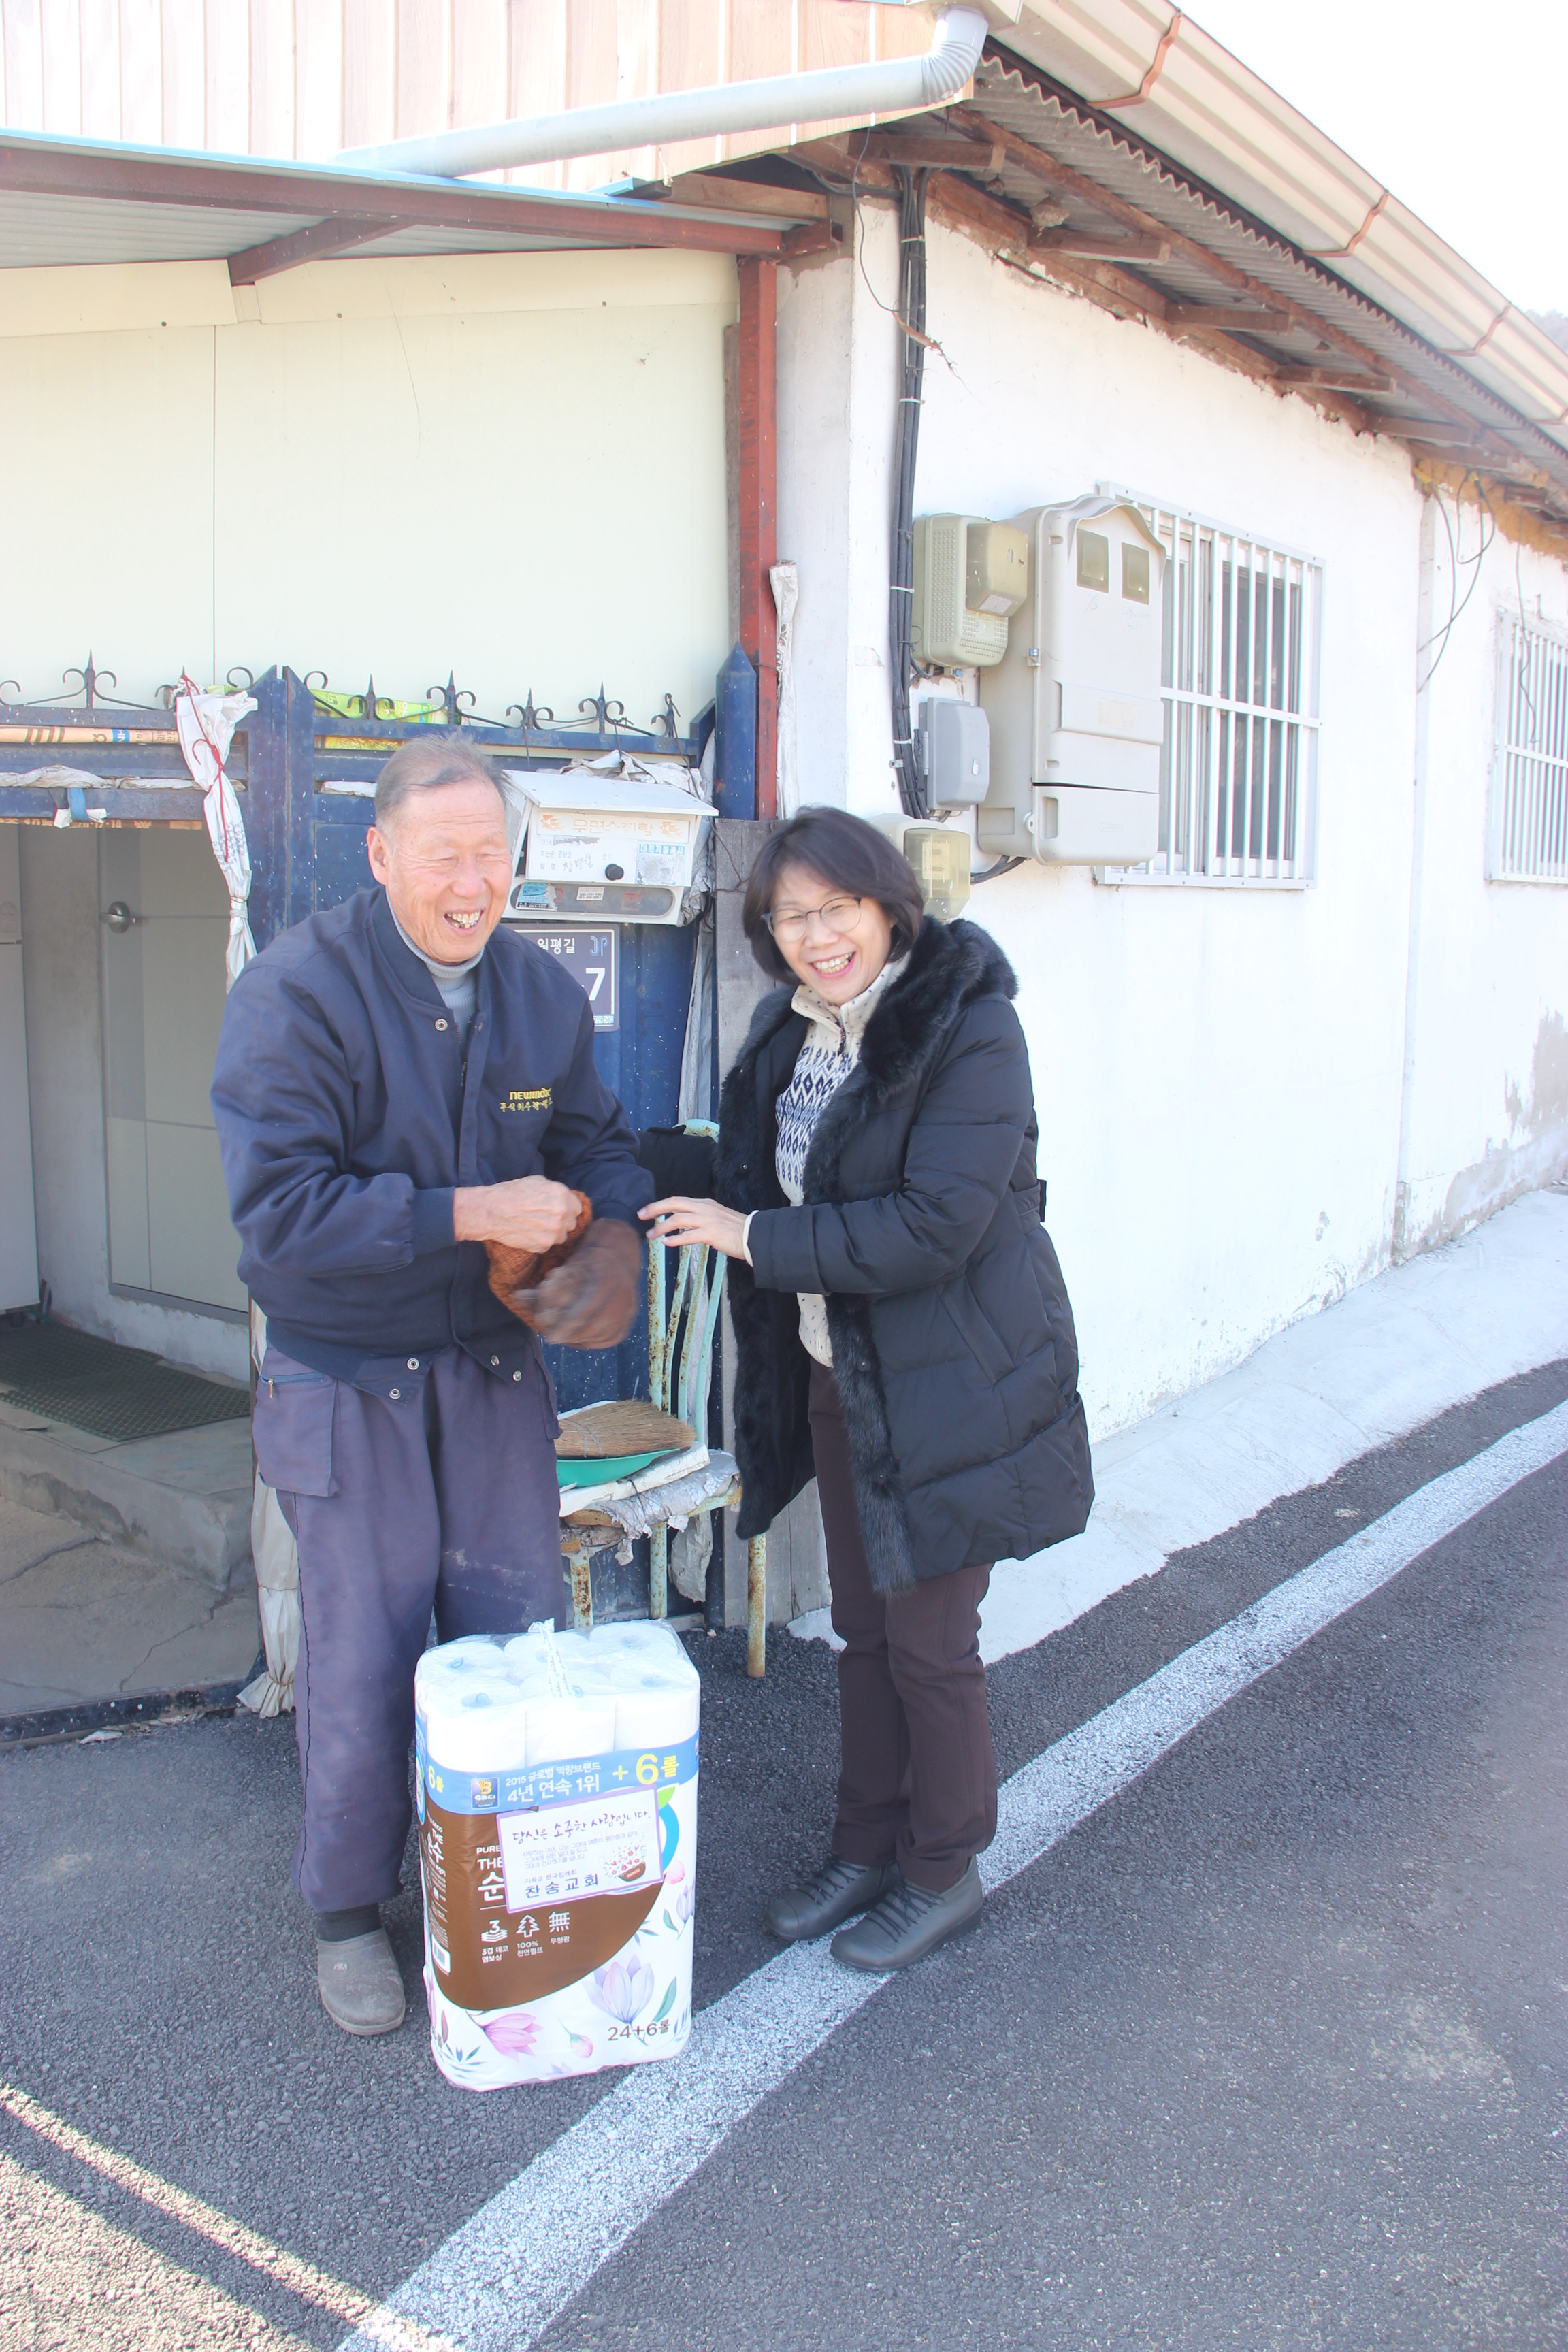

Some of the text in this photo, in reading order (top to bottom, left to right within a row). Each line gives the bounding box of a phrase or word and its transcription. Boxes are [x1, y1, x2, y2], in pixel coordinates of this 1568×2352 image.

[582, 967, 606, 1001] 7
[506, 1761, 602, 1787] 2015 글로벌 역량브랜드
[507, 1773, 600, 1803] 4년 연속 1위
[512, 1810, 651, 1844] 당신은 소중한 사람입니다.
[489, 1919, 501, 1933] 3
[548, 1911, 571, 1933] 無
[517, 1940, 539, 1949] 100%
[517, 1946, 543, 1957] 천연펄프
[550, 1936, 570, 1945] 무형광
[608, 2019, 670, 2041] 24+6롤
